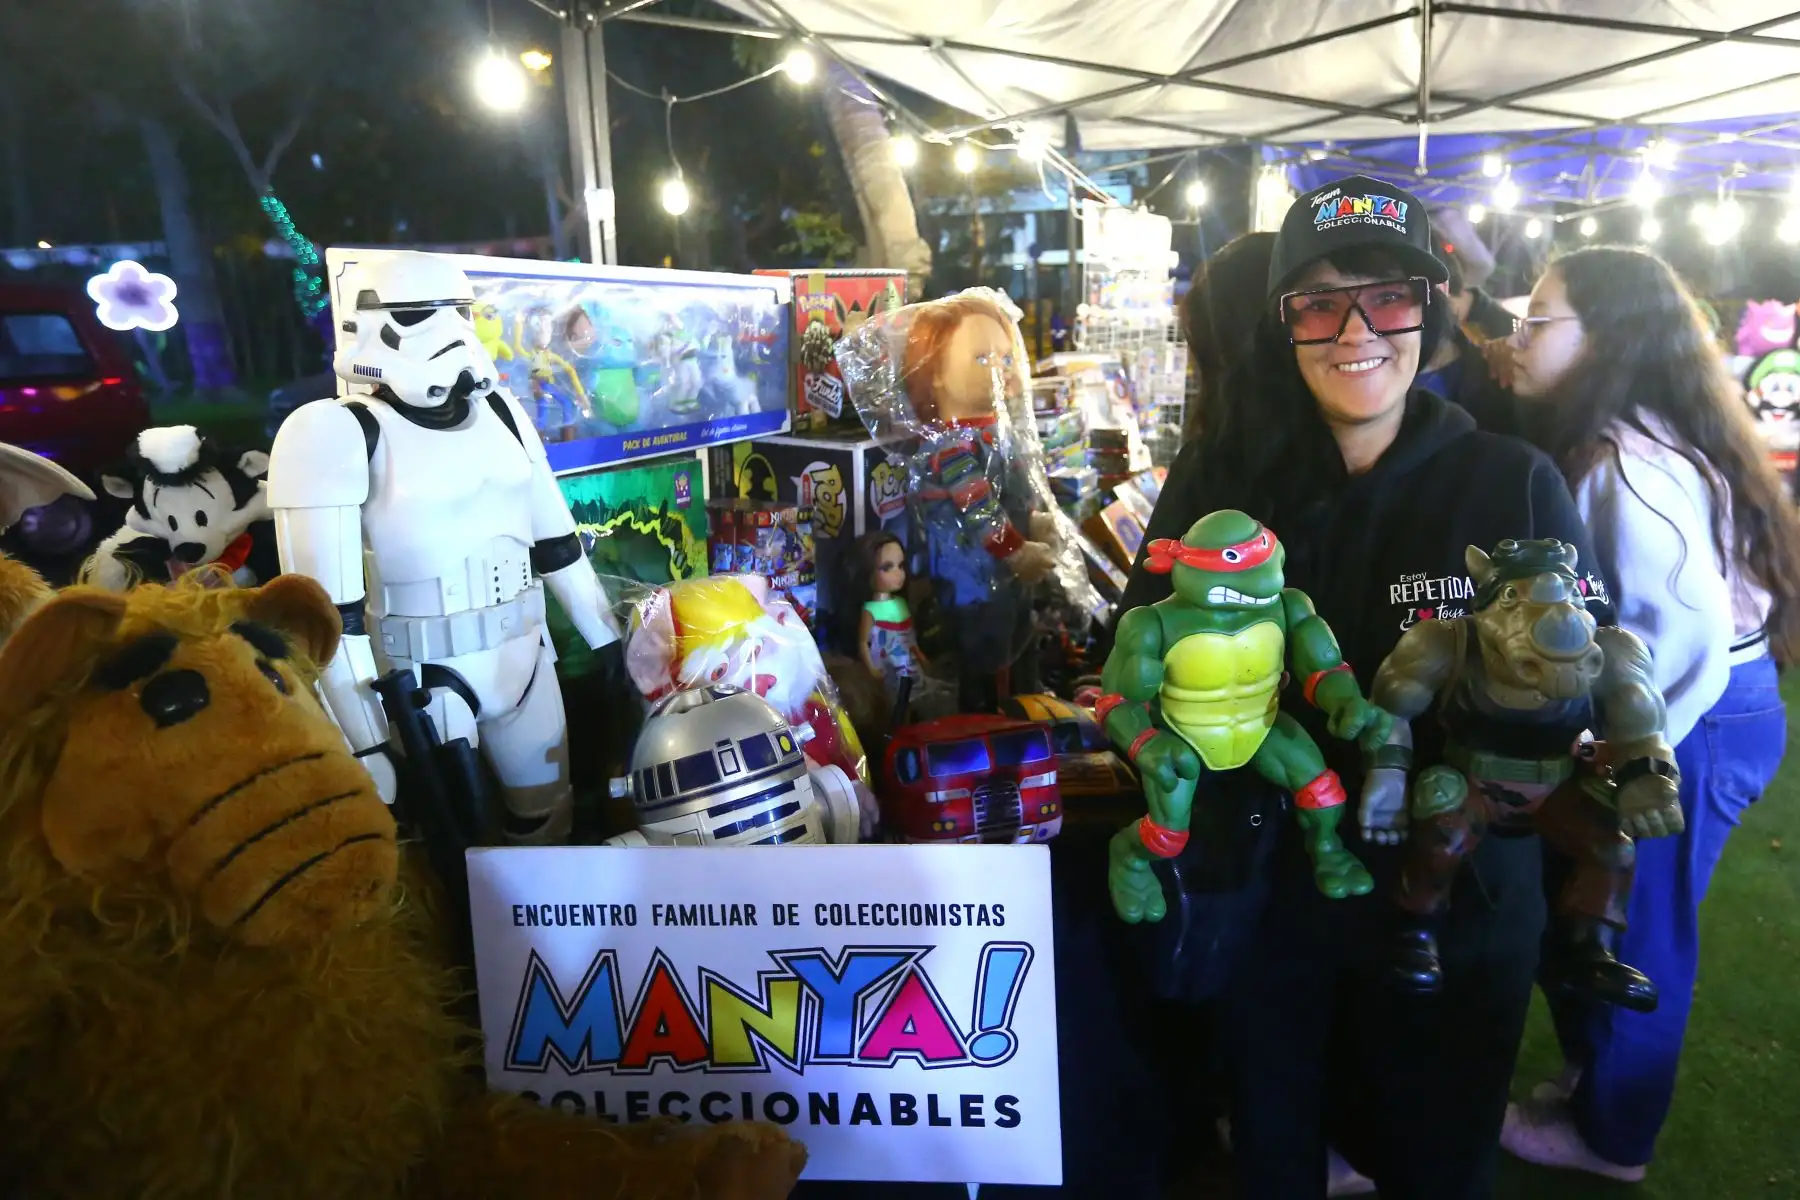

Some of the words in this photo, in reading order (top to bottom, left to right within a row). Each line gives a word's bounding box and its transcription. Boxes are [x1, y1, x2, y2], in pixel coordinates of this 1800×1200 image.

[1310, 187, 1341, 209] Team
[1314, 194, 1408, 224] MANYA!
[1317, 216, 1407, 234] COLECCIONABLES
[1400, 572, 1427, 583] Estoy
[1390, 576, 1475, 604] REPETIDA
[512, 904, 637, 927] ENCUENTRO
[652, 904, 758, 926] FAMILIAR
[773, 904, 800, 926] DE
[814, 903, 1006, 927] COLECCIONISTAS
[504, 941, 1034, 1076] MANYA!
